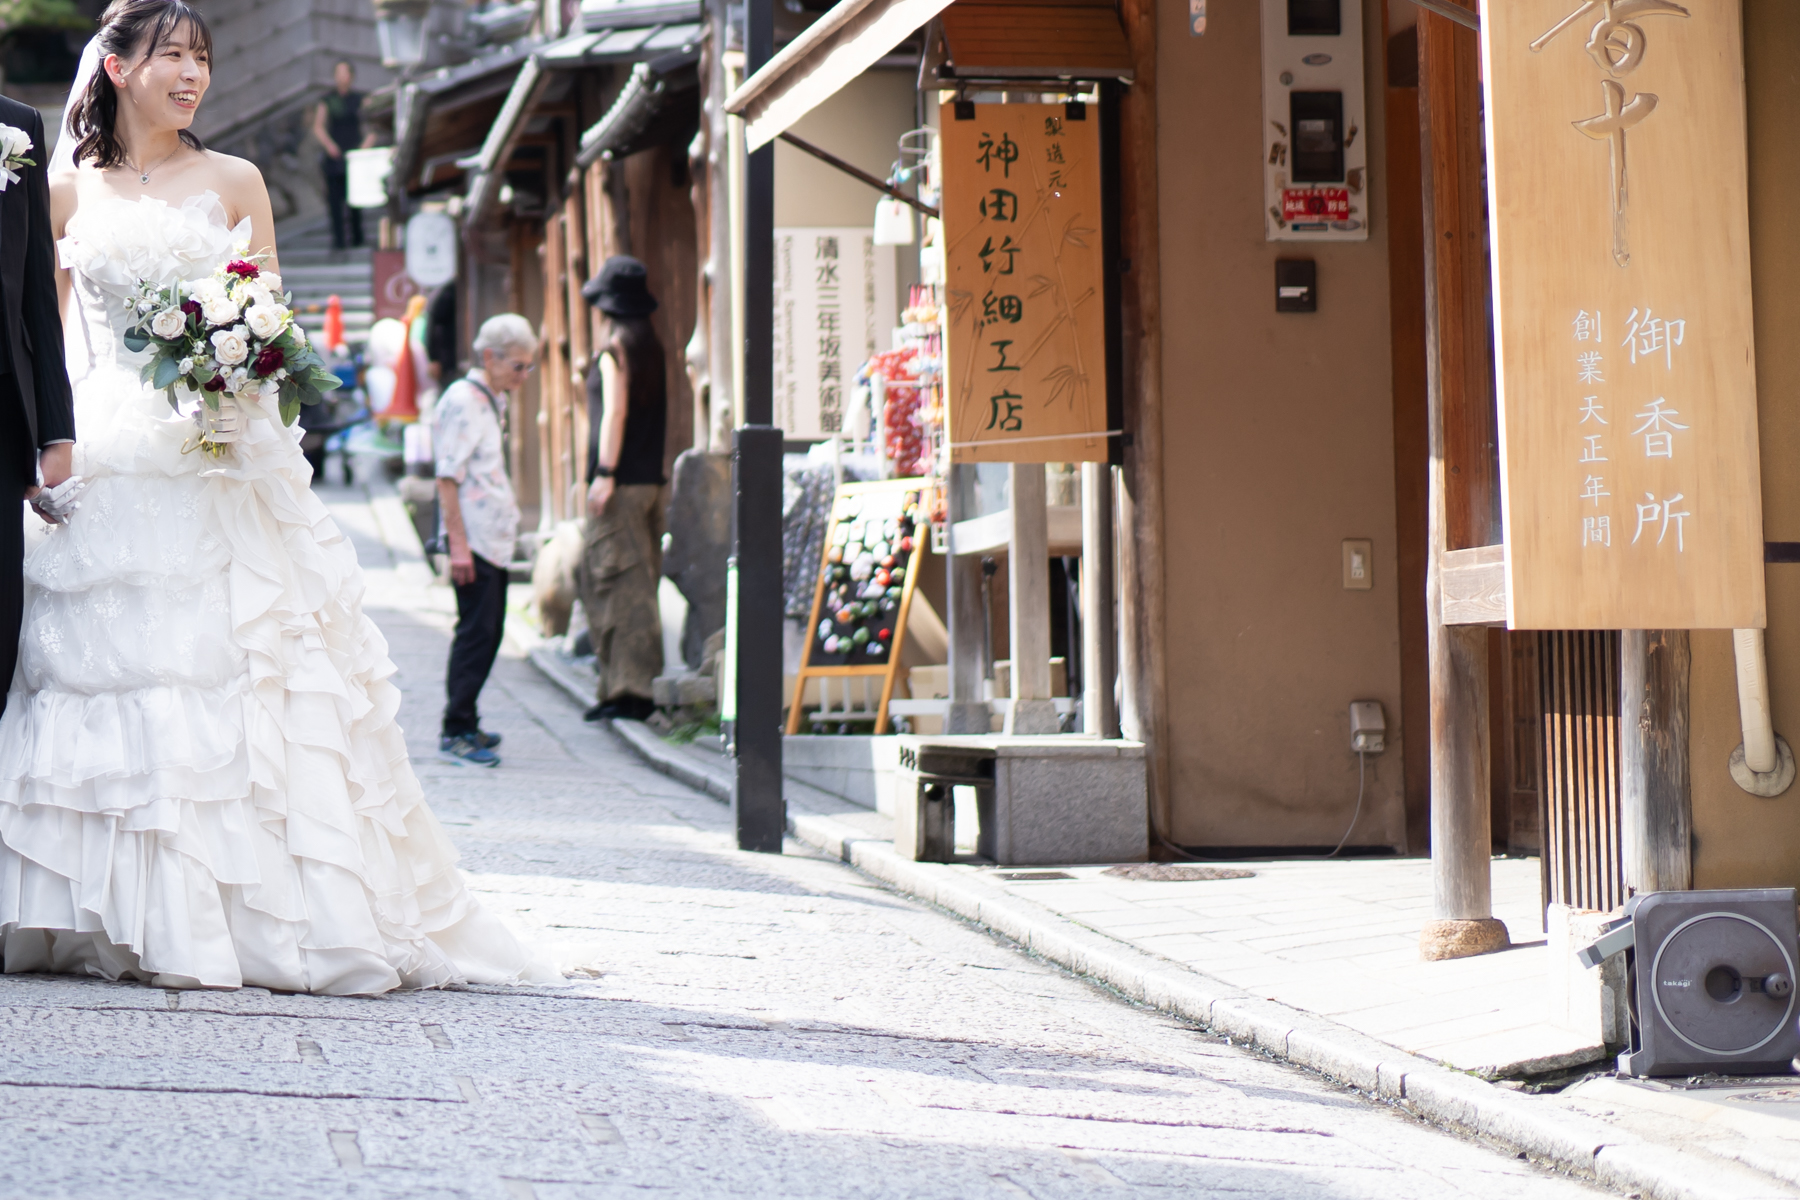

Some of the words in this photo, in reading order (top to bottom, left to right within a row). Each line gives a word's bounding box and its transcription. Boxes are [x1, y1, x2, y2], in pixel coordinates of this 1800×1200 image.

[1044, 116, 1068, 189] 製造元
[815, 236, 843, 433] 清水三年坂美術館
[975, 131, 1024, 432] 神田竹細工店
[1572, 309, 1612, 548] 創業天正年間
[1621, 307, 1691, 553] 御香所
[1663, 980, 1690, 988] takagi
